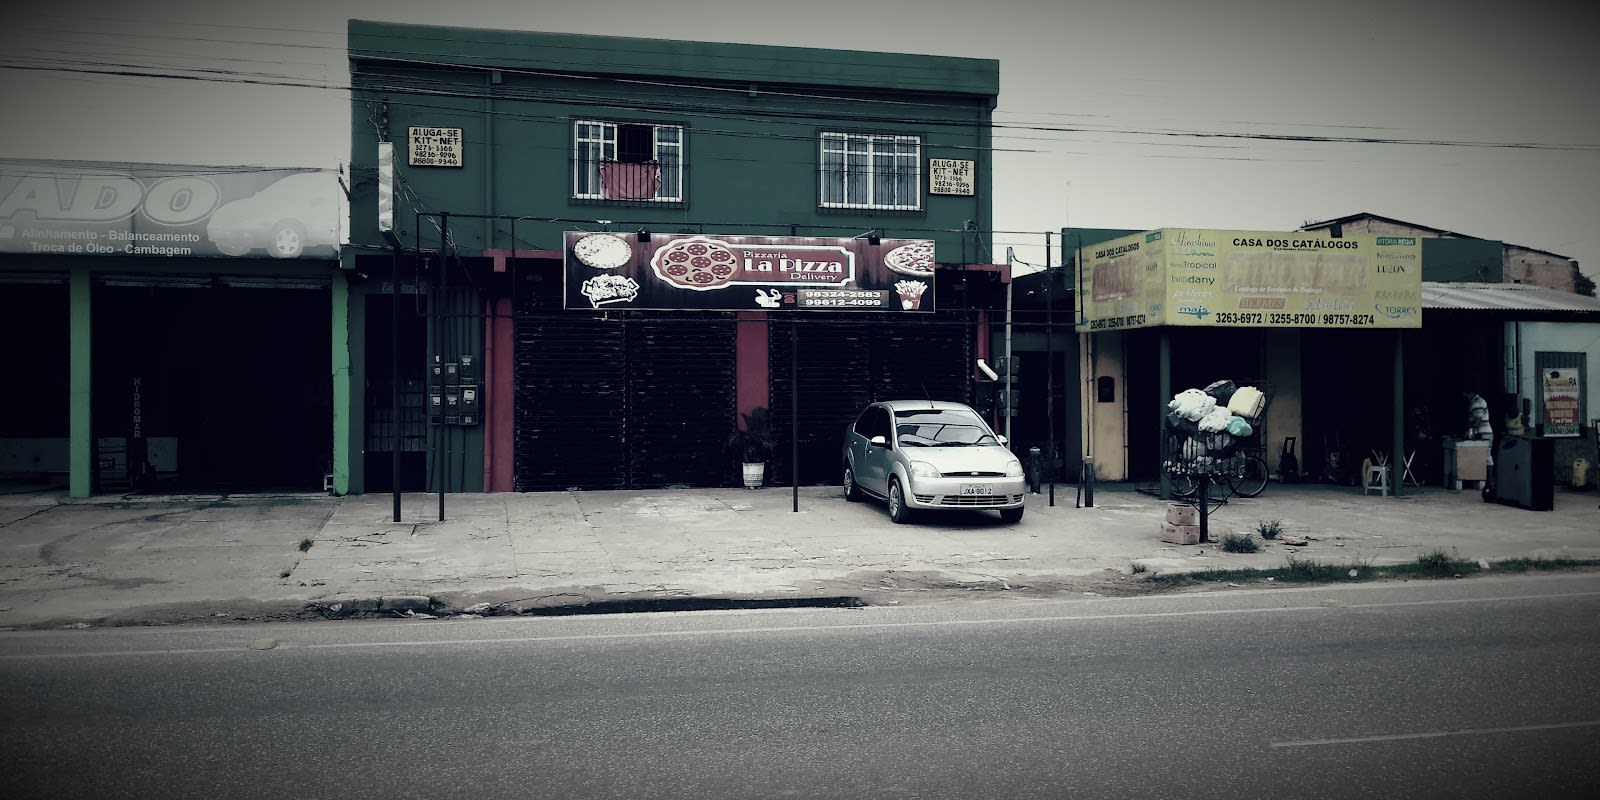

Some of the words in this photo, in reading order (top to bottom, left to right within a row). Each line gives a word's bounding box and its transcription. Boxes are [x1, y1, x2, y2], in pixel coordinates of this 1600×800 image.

[412, 128, 458, 137] ALUGA-SE
[414, 137, 459, 145] KIT-NET
[932, 160, 969, 169] ALUGA-SE
[933, 168, 969, 176] KIT-NET
[21, 228, 98, 241] Alinhamento
[109, 230, 200, 242] Balanceamento
[1232, 238, 1263, 247] CASA
[1266, 239, 1289, 248] DOS
[1292, 238, 1359, 249] CATÁLOGOS
[31, 242, 64, 254] Troca
[67, 243, 82, 253] de
[86, 241, 113, 254] Óleo
[125, 244, 191, 256] Cambagem
[743, 251, 788, 259] Pizzaria
[744, 259, 773, 272] La
[779, 259, 842, 273] Pizza
[790, 272, 837, 281] Delivery
[1171, 275, 1215, 285] biodany
[1215, 312, 1262, 324] 3263-6972
[1269, 313, 1316, 325] 3255-8700
[1323, 314, 1375, 325] 98757-8274
